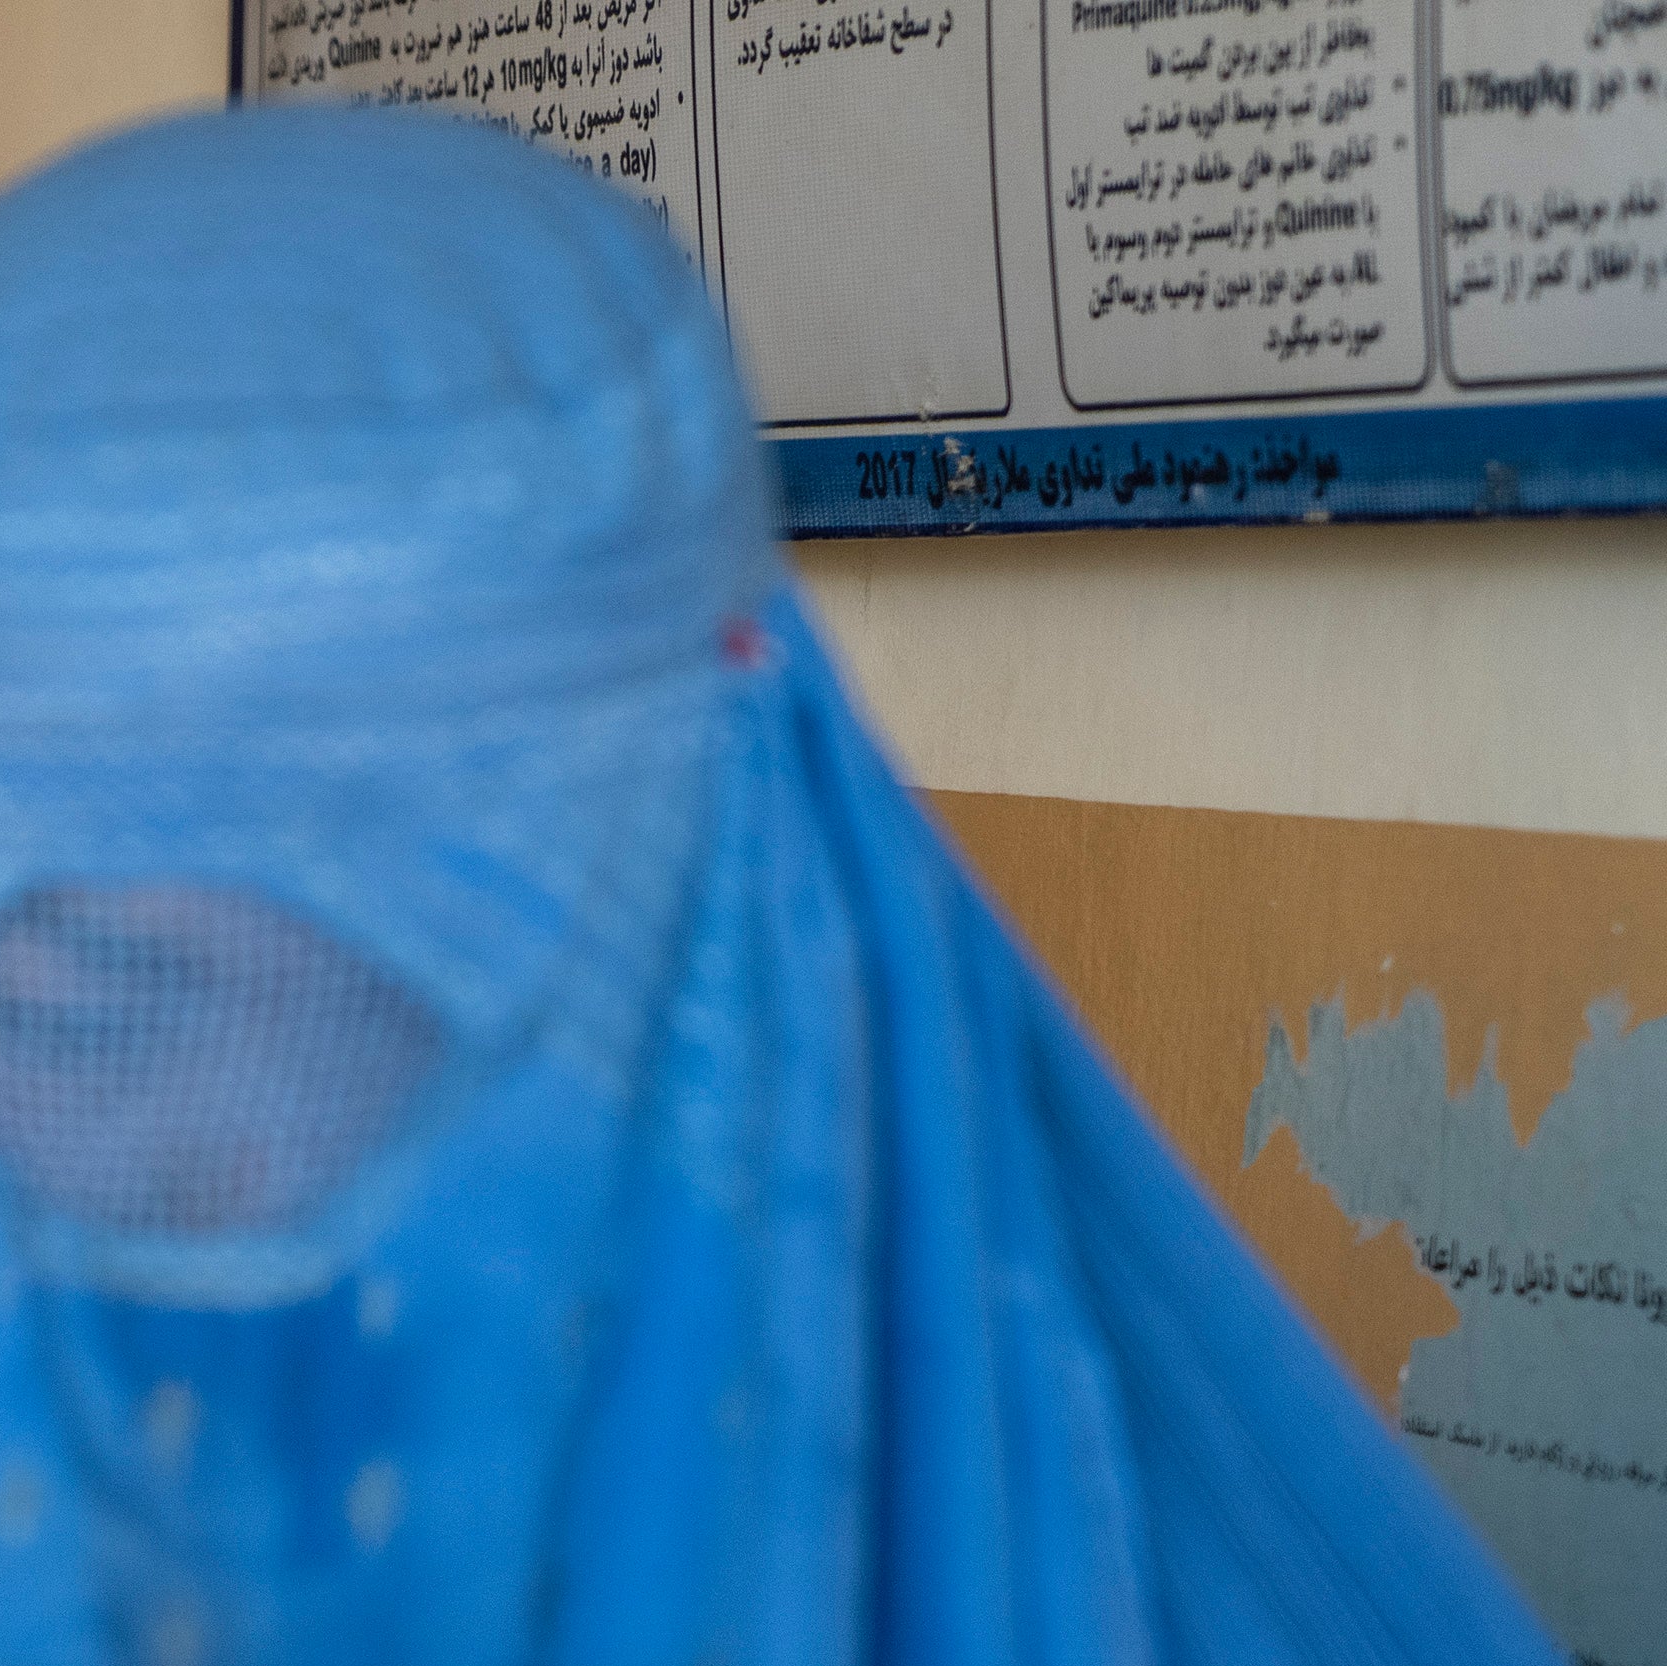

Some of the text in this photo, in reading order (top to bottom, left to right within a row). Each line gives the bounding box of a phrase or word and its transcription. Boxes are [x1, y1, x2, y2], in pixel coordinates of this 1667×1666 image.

[494, 5, 530, 38] ساعت
[534, 0, 553, 31] 48
[891, 6, 931, 54] سطح
[327, 30, 381, 68] Quinine
[609, 46, 629, 86] دوز
[632, 32, 663, 74] باشد
[462, 63, 479, 97] 12
[629, 87, 660, 131] ادویه
[601, 152, 613, 178] a
[1274, 196, 1357, 238] Quinine
[856, 451, 916, 499] 2017
